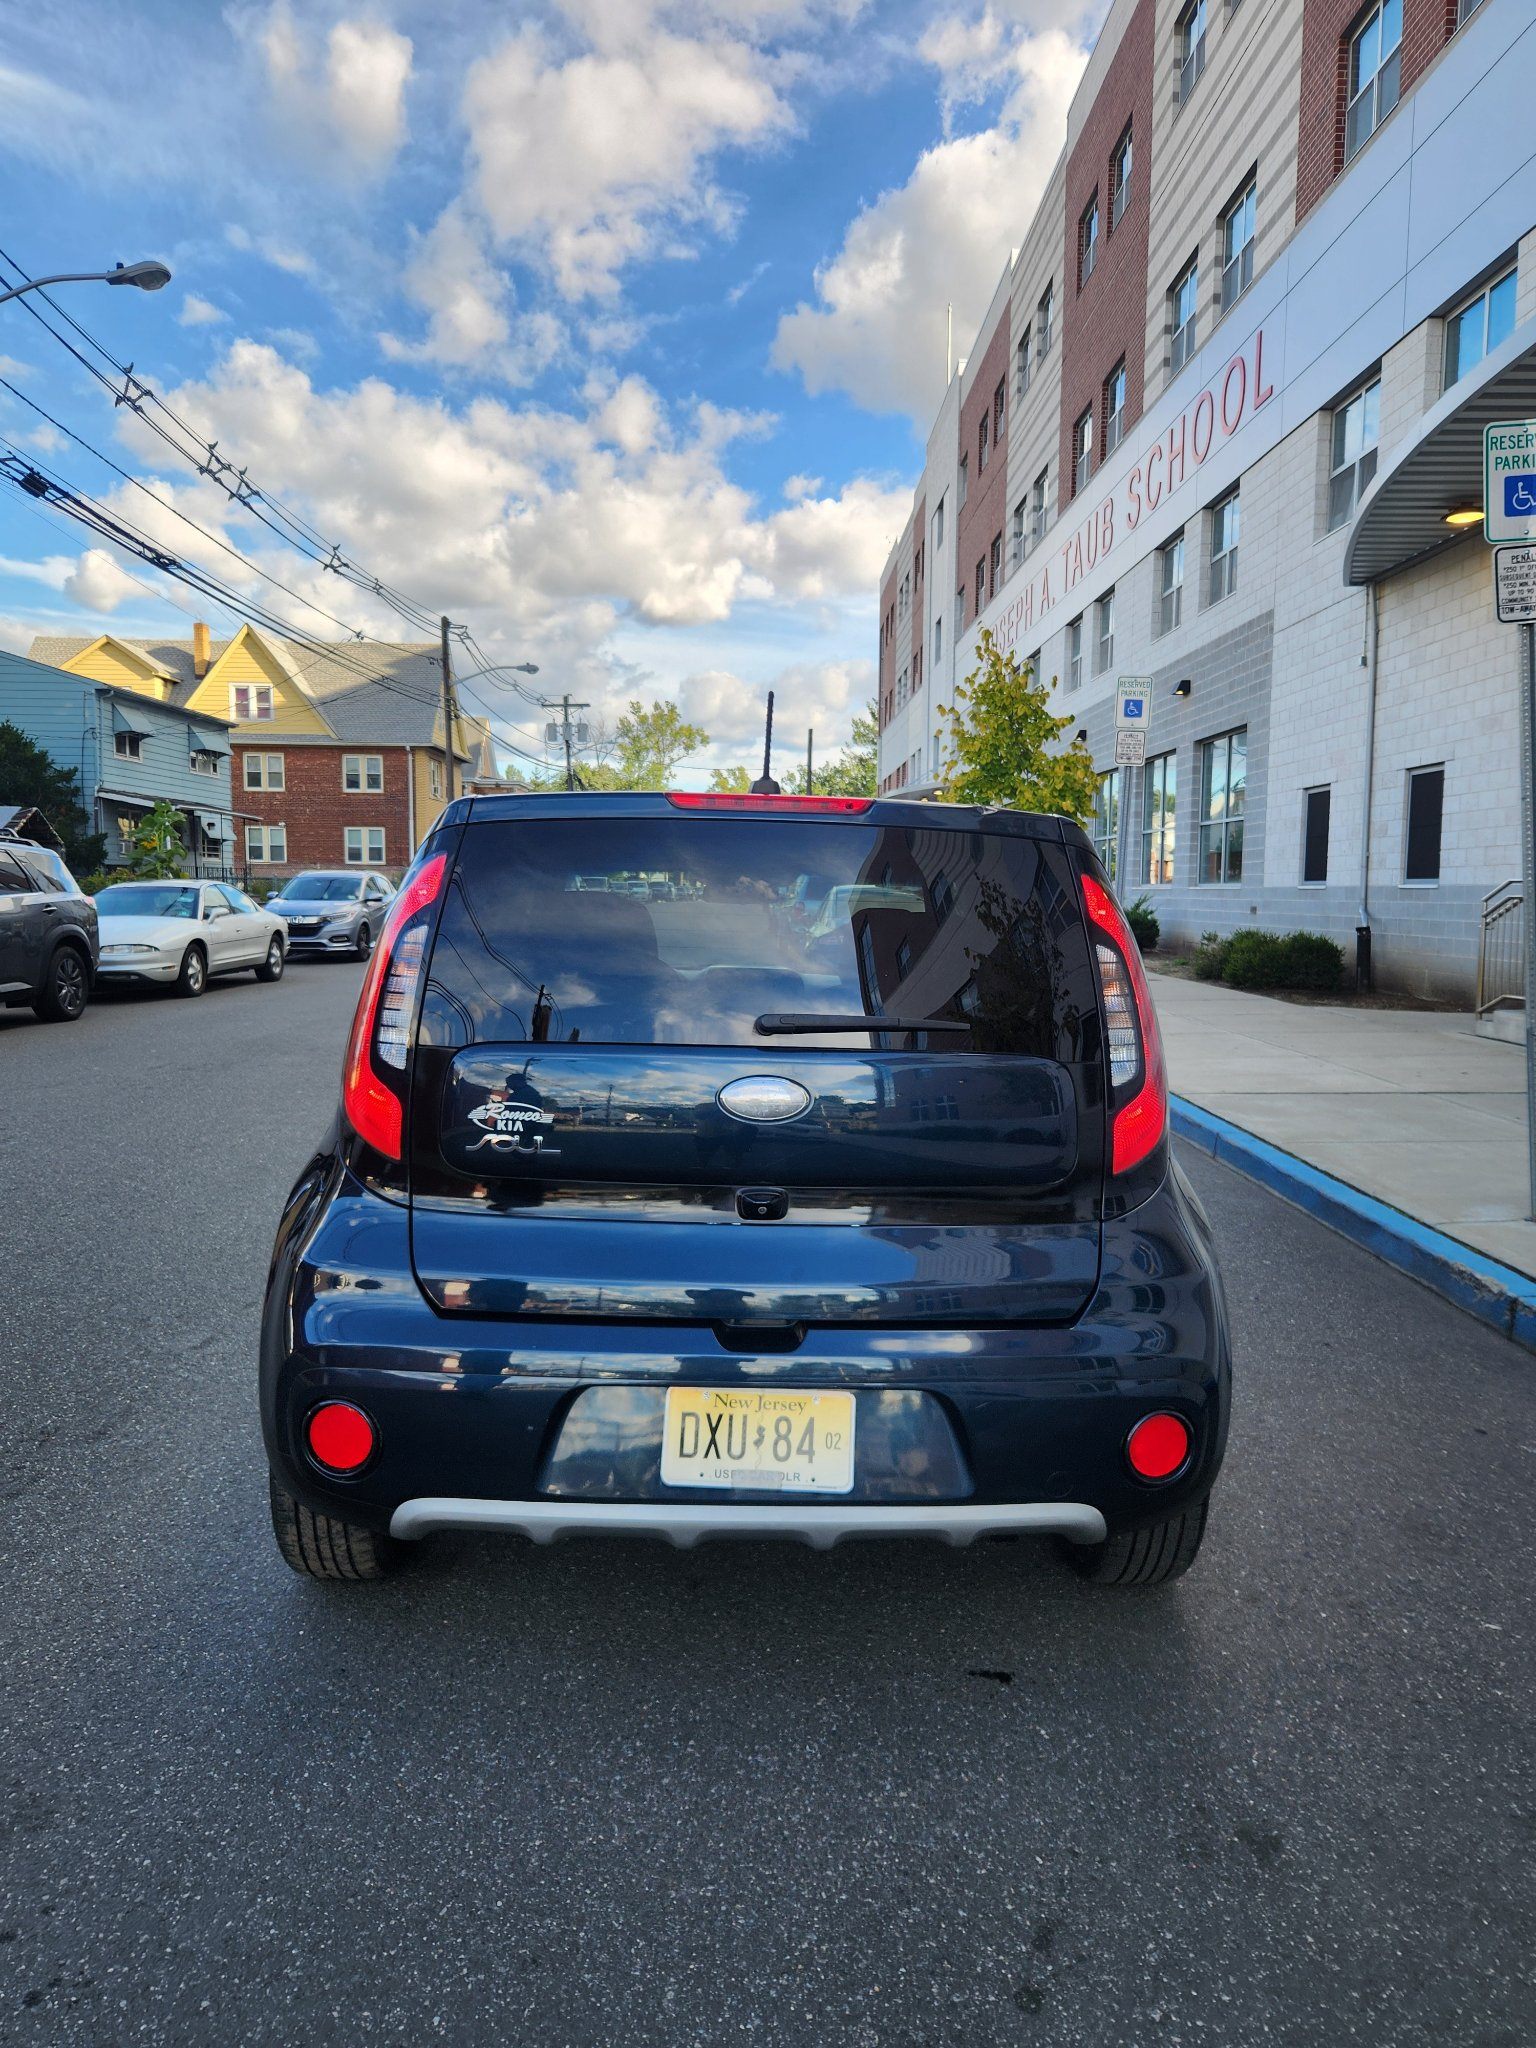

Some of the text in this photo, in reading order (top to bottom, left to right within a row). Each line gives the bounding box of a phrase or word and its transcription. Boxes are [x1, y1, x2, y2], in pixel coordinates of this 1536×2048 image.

[1490, 433, 1536, 451] RESER
[987, 330, 1274, 655] OSEPH A. TAUB SCHOOL
[1511, 553, 1536, 564] PENAL
[1120, 680, 1151, 689] RESERVED
[485, 1102, 543, 1121] Romeo
[497, 1119, 524, 1132] KIA
[713, 1393, 808, 1415] New Jersey
[772, 1415, 816, 1464] 84
[825, 1432, 842, 1450] 02
